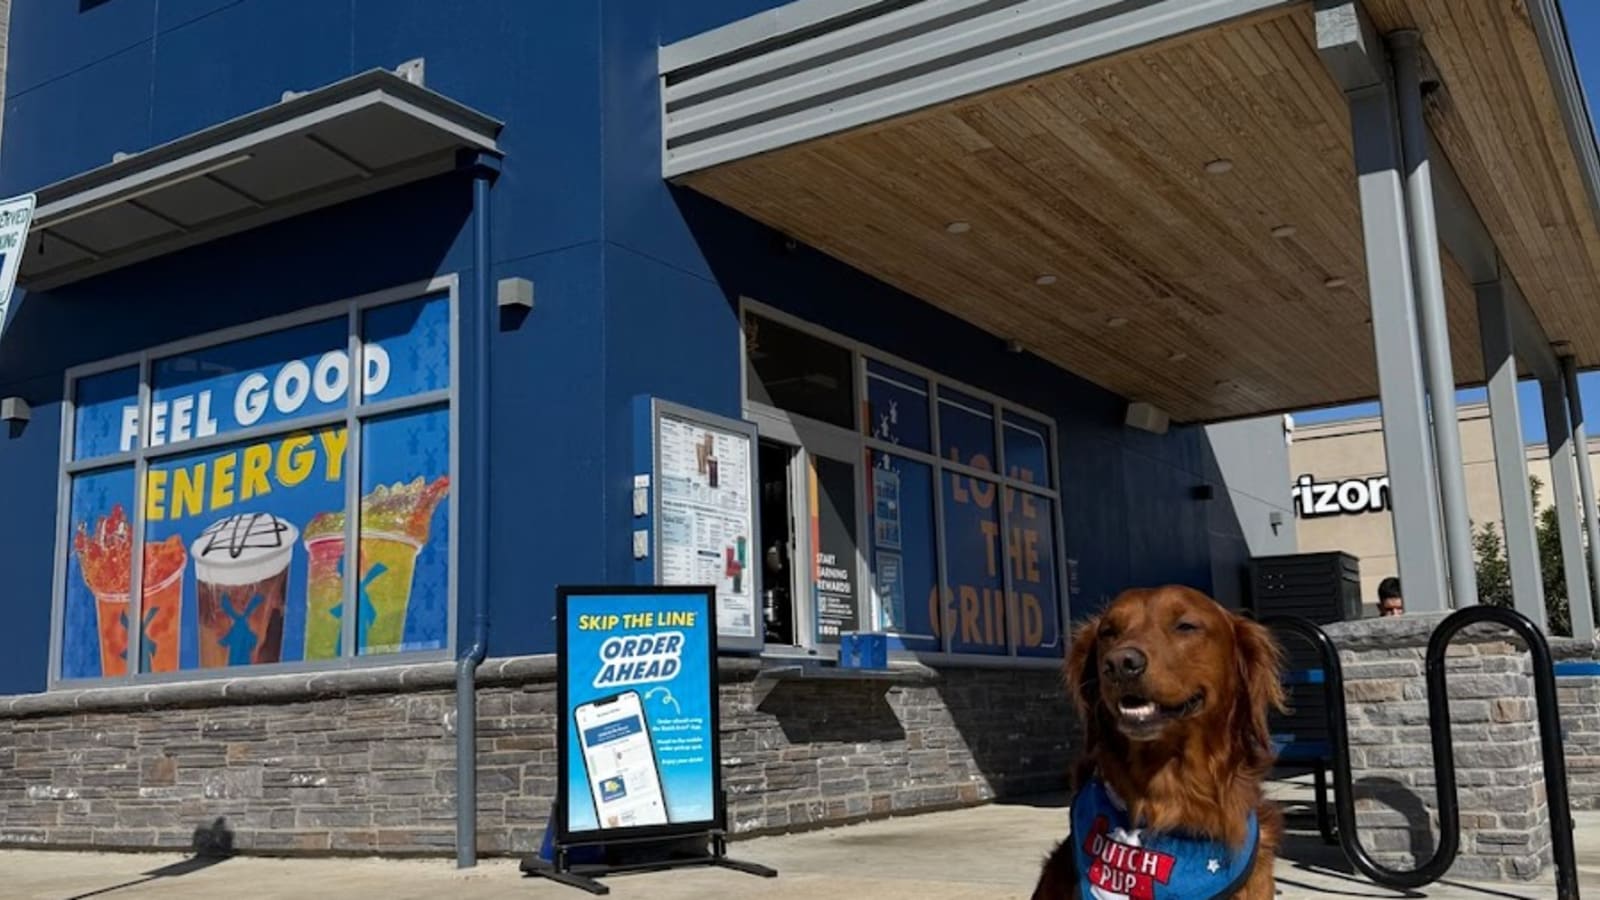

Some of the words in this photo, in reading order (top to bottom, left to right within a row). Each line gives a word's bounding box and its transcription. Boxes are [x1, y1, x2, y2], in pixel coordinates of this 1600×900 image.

[120, 390, 217, 451] FEEL
[234, 343, 390, 426] GOOD
[147, 426, 348, 521] ENERGY
[980, 520, 1040, 583] THE
[578, 614, 620, 630] SKIP
[622, 612, 654, 629] THE
[657, 611, 695, 626] LINE
[928, 583, 1044, 647] GRIND
[603, 635, 681, 660] ORDER
[598, 659, 678, 684] AHEAD
[1092, 833, 1158, 876] DUTCH
[1100, 864, 1137, 893] PUP
